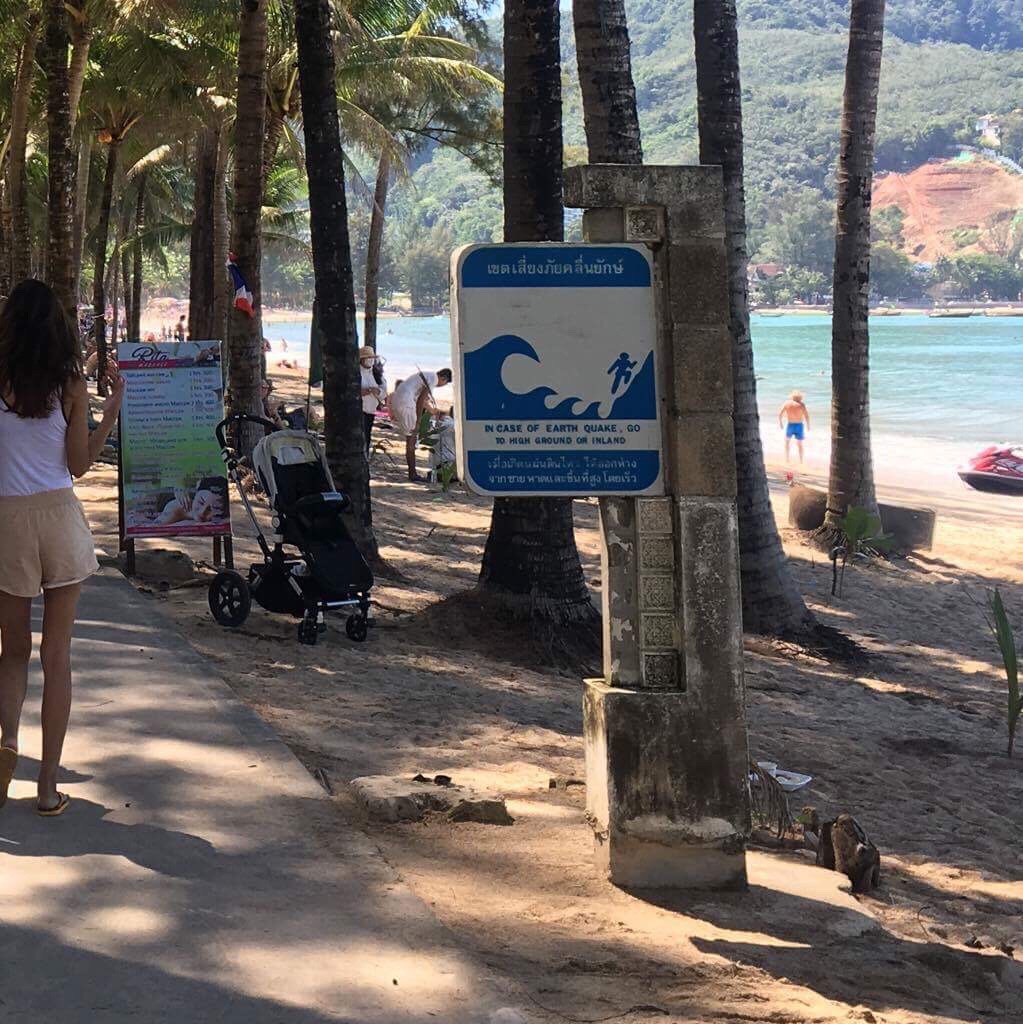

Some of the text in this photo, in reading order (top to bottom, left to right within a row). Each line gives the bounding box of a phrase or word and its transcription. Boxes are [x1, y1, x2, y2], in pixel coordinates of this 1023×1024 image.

[485, 424, 494, 433] IN
[496, 424, 523, 433] CASE
[527, 424, 540, 433] OF
[546, 424, 578, 433] EARTH
[627, 424, 641, 433] GO
[495, 437, 626, 445] TO HIGH GROUND OR INLAND
